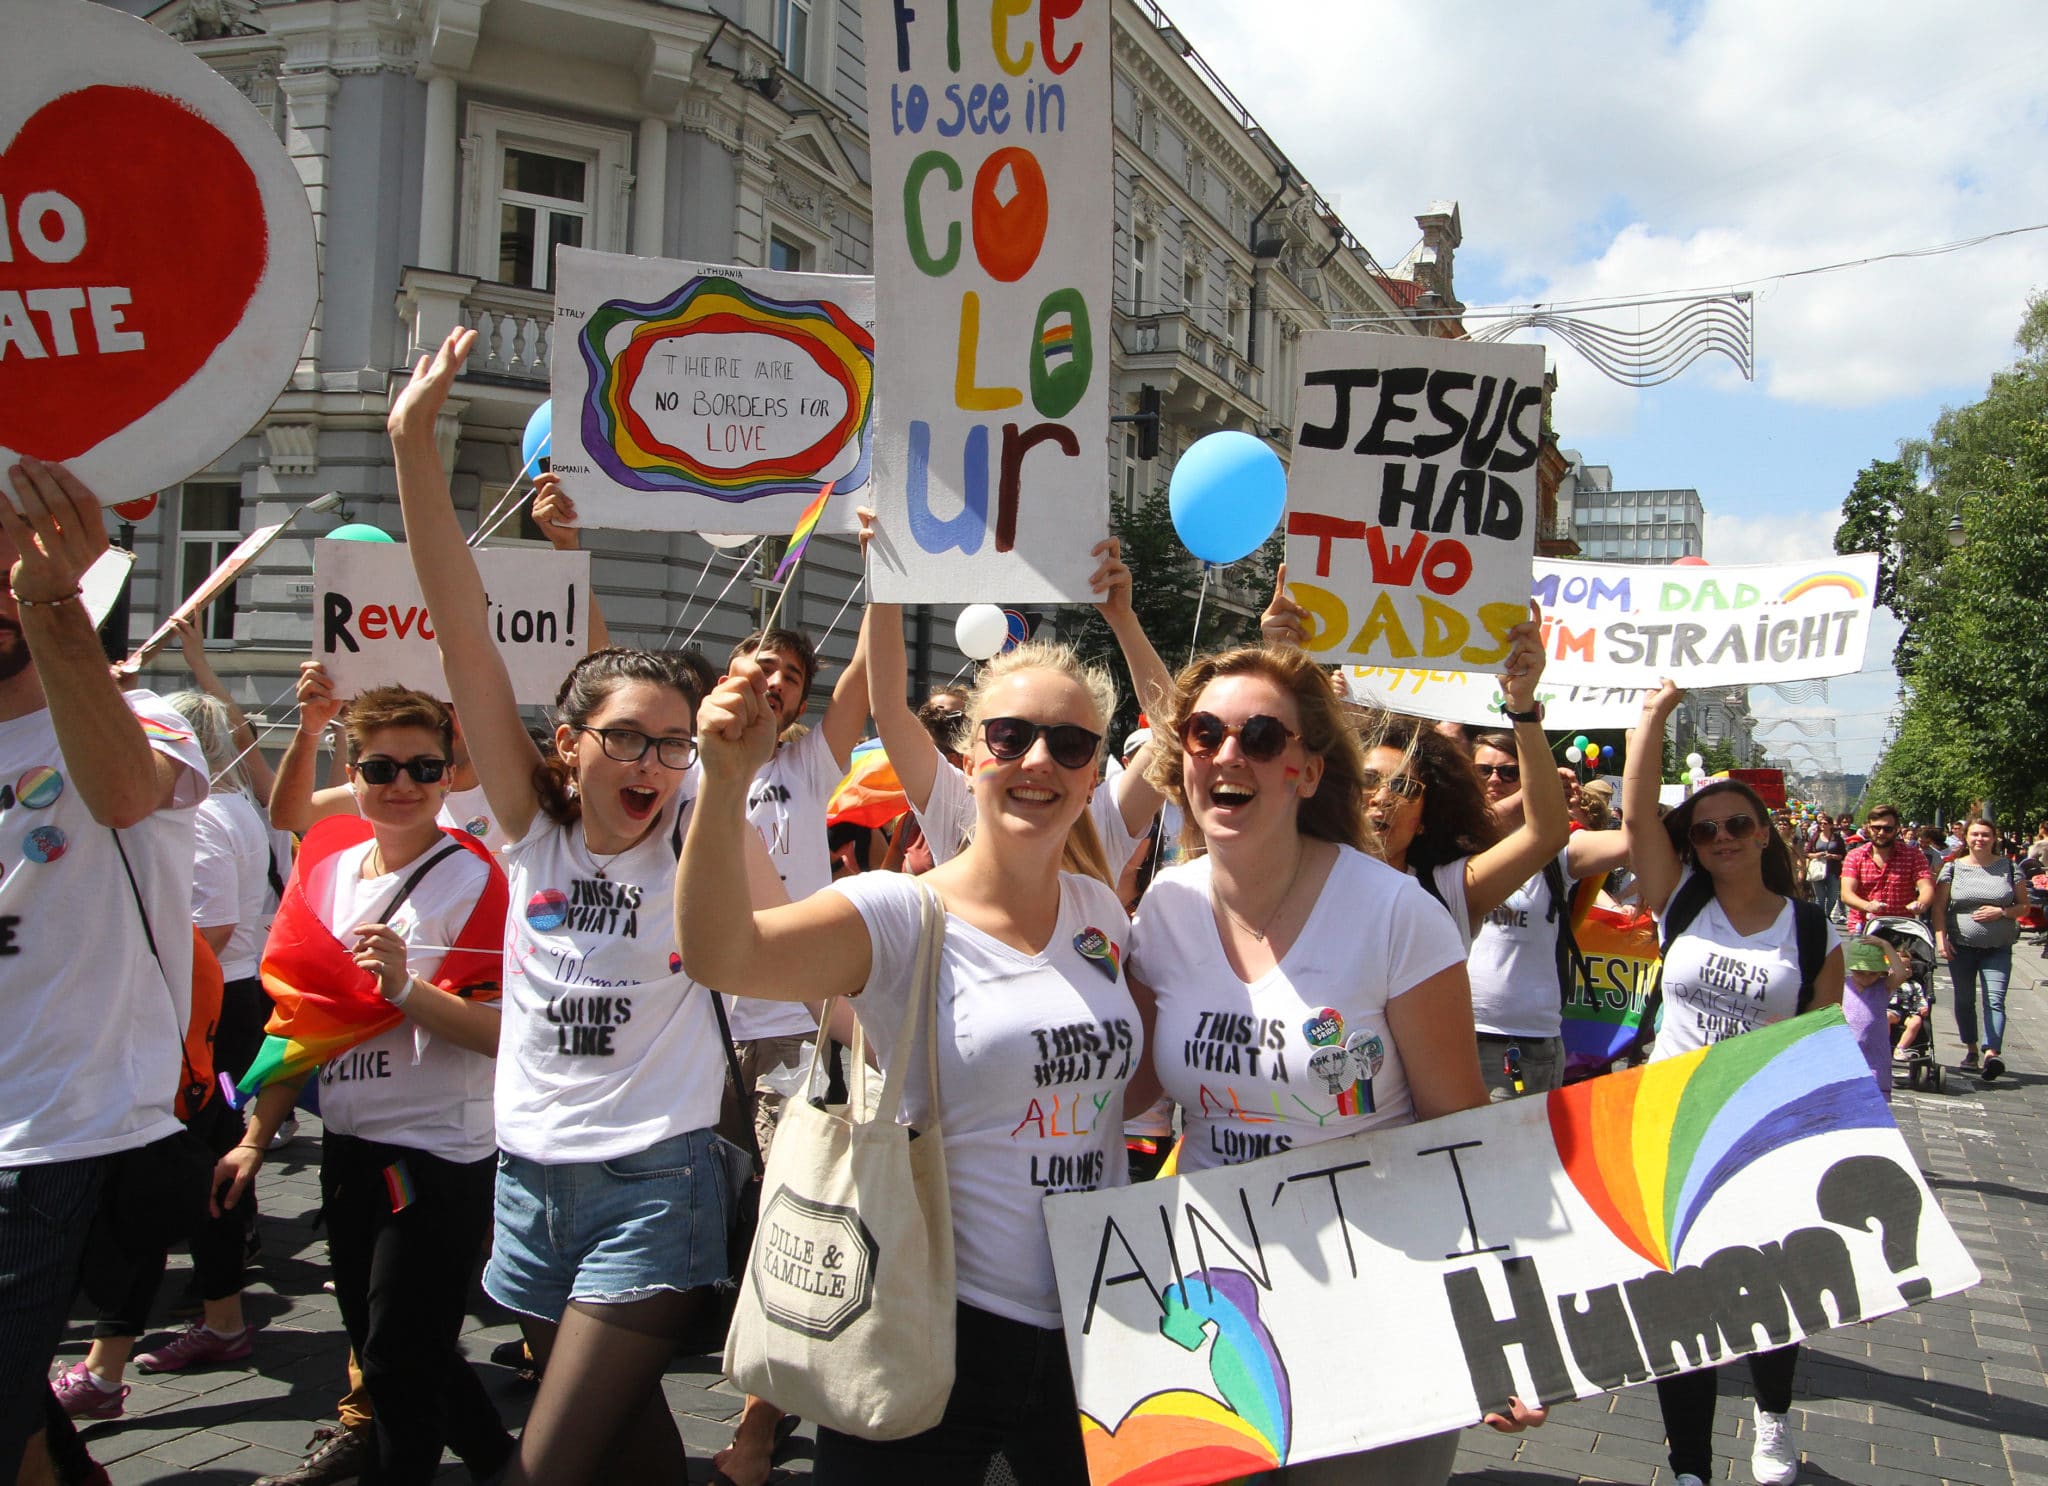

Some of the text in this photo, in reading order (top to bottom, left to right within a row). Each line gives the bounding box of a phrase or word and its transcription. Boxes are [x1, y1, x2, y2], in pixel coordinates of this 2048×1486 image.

[891, 78, 1065, 137] to see in
[0, 189, 87, 263] O
[558, 307, 585, 319] ITALY
[662, 354, 794, 380] THERE ARE
[656, 390, 830, 418] NO BORDERS FOR
[1299, 367, 1542, 473] JESUS
[707, 423, 767, 452] LOVE
[552, 463, 590, 475] ROMANIA
[1379, 462, 1523, 541] HAD
[1288, 511, 1473, 595] TWO
[1286, 582, 1531, 665] DADS
[571, 879, 644, 910] THIS IS
[562, 906, 637, 938] WHAT A
[1700, 966, 1766, 1002] WHAT A
[1706, 952, 1769, 985] THIS IS
[546, 996, 632, 1025] LOOKS
[1311, 1018, 1336, 1036] BALTIC
[1697, 1012, 1751, 1035] LOOKS
[558, 1025, 616, 1057] LIKE
[1031, 1019, 1132, 1061] THIS IS
[1194, 1011, 1286, 1050] THIS IS
[340, 1050, 391, 1081] LIKE
[1034, 1051, 1112, 1088] WHAT
[1114, 1050, 1131, 1079] A
[1184, 1039, 1289, 1083] WHAT A
[1010, 1090, 1111, 1140] ALLY
[1211, 1124, 1293, 1158] LOOKS
[1030, 1150, 1104, 1187] LOOKS
[769, 1222, 844, 1270] DILLE &
[1082, 1140, 1511, 1335] AIN'T I
[762, 1246, 847, 1299] KAMILLE
